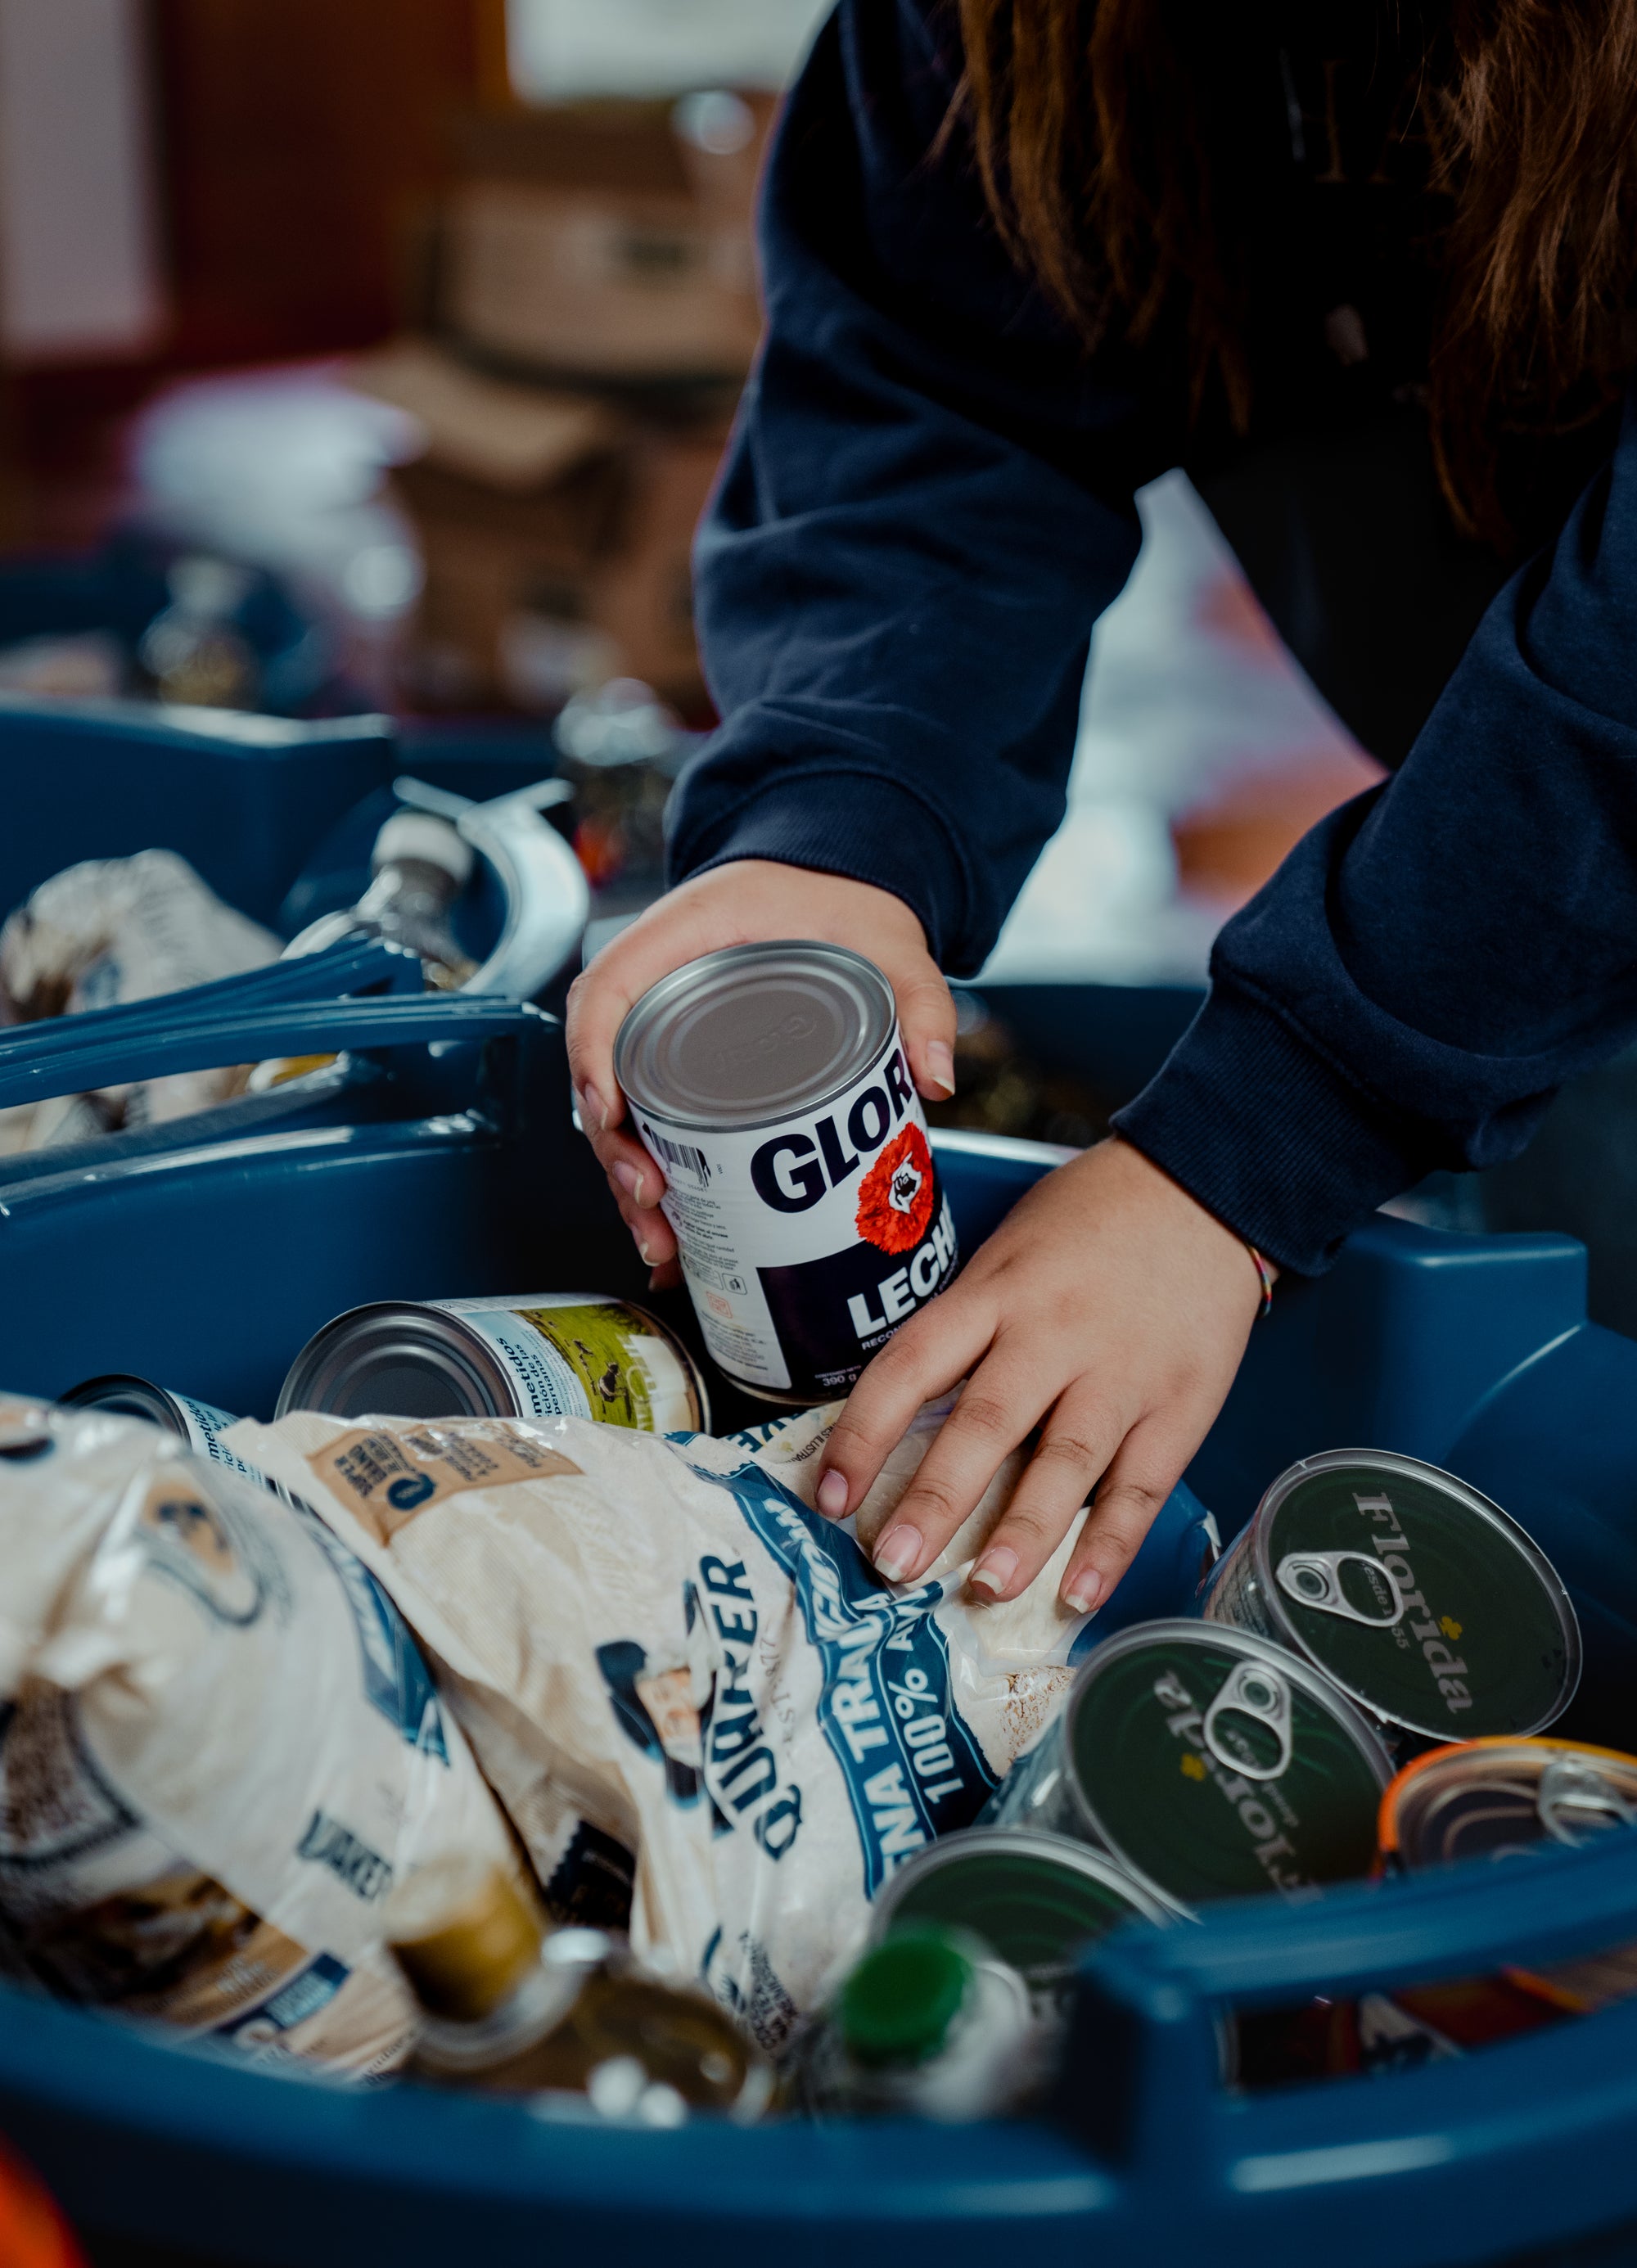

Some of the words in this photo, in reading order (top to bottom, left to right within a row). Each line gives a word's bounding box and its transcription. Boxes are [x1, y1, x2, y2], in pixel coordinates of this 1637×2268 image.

[496, 1337, 542, 1417] metidos
[515, 1344, 530, 1359] las
[528, 1362, 540, 1377] de
[531, 1355, 562, 1415] peruanas
[538, 1381, 552, 1416] ición
[822, 1375, 846, 1387] 390
[1352, 1492, 1472, 1714] Florida
[1362, 1563, 1387, 1605] esde
[700, 1555, 803, 1863] QUAKER
[886, 1667, 964, 1804] 100%
